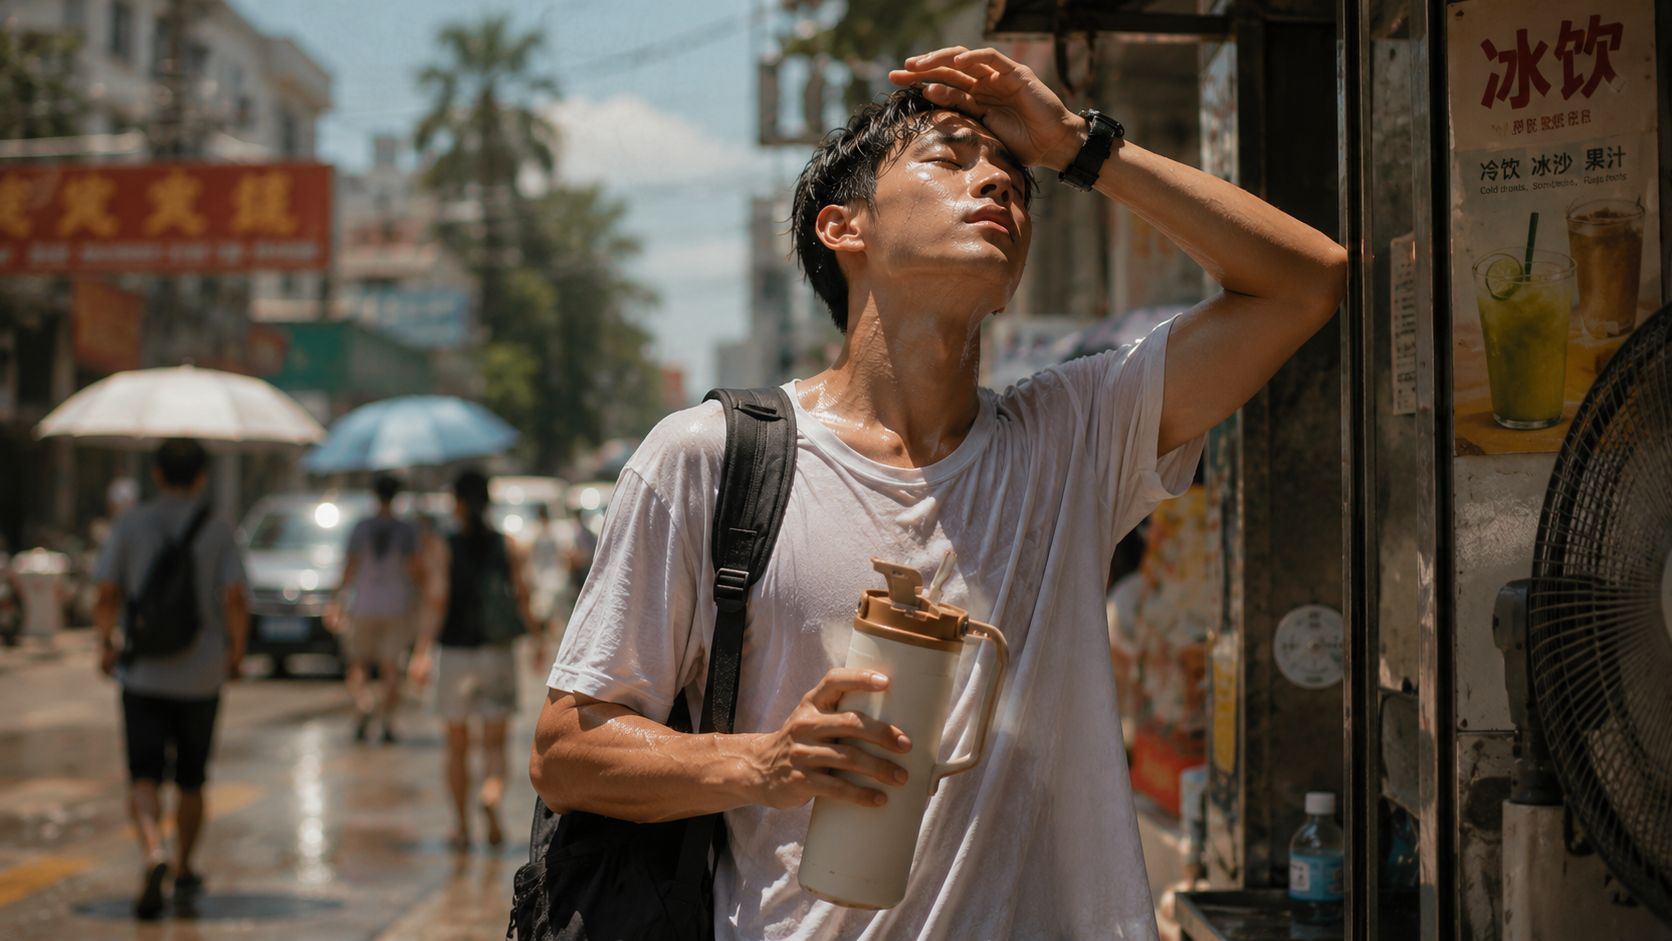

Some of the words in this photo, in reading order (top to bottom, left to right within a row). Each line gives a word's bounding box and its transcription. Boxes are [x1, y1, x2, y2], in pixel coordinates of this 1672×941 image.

[1480, 14, 1625, 110] 冰饮
[1480, 157, 1521, 182] 冷饮
[1531, 152, 1573, 177] 冰沙
[1585, 145, 1627, 171] 果汁
[1480, 185, 1498, 195] Cold
